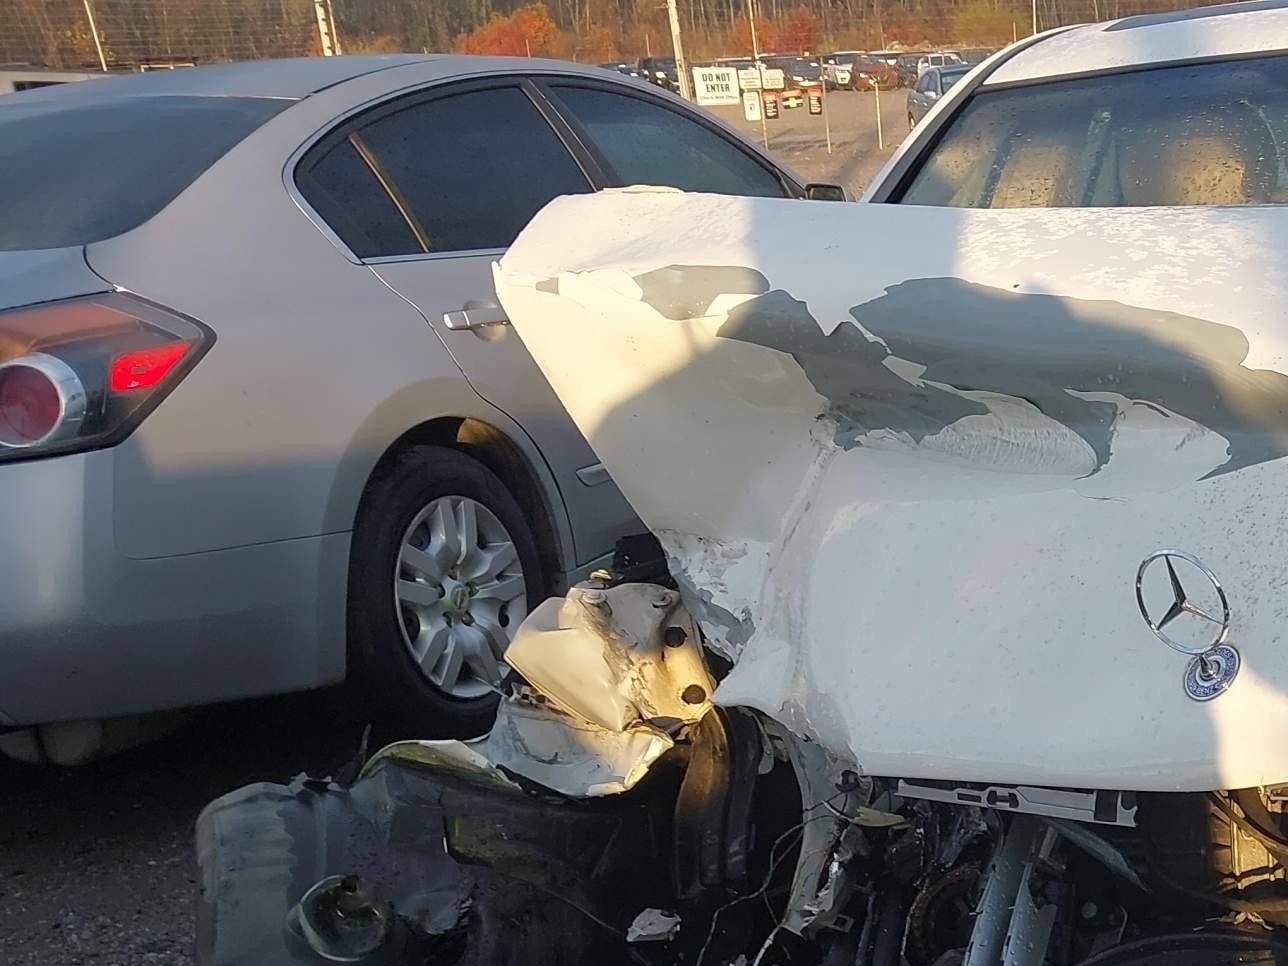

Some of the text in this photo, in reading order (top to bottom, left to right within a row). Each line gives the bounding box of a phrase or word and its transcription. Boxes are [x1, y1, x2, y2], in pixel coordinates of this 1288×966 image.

[702, 73, 730, 82] DO NOT
[706, 84, 730, 92] ENTER
